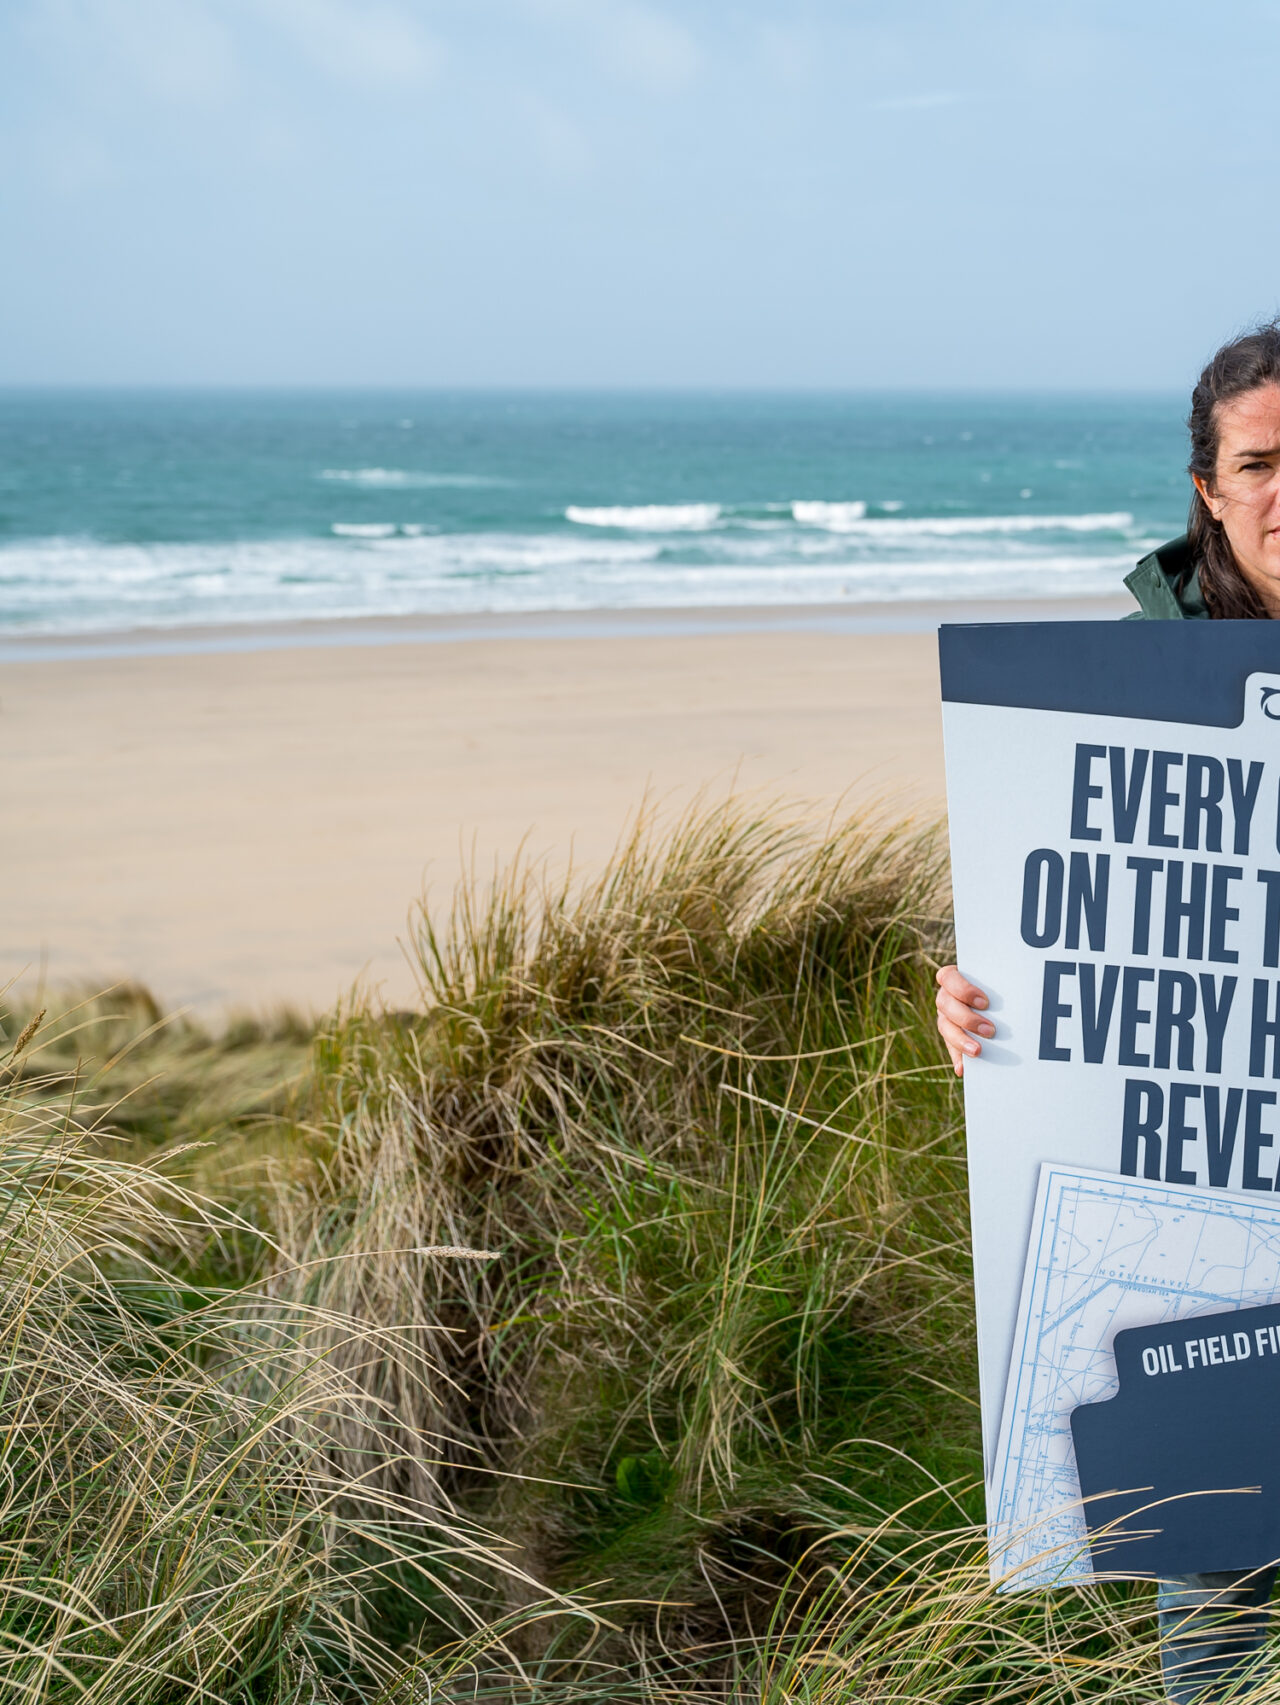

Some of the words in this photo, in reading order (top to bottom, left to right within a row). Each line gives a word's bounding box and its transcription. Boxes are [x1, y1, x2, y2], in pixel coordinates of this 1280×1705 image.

[1069, 742, 1265, 856] EVERY
[1020, 848, 1111, 953] ON
[1126, 855, 1244, 965] THE
[1038, 960, 1239, 1075] EVERY
[1141, 1344, 1183, 1376] OIL
[1184, 1332, 1251, 1369] FIELD
